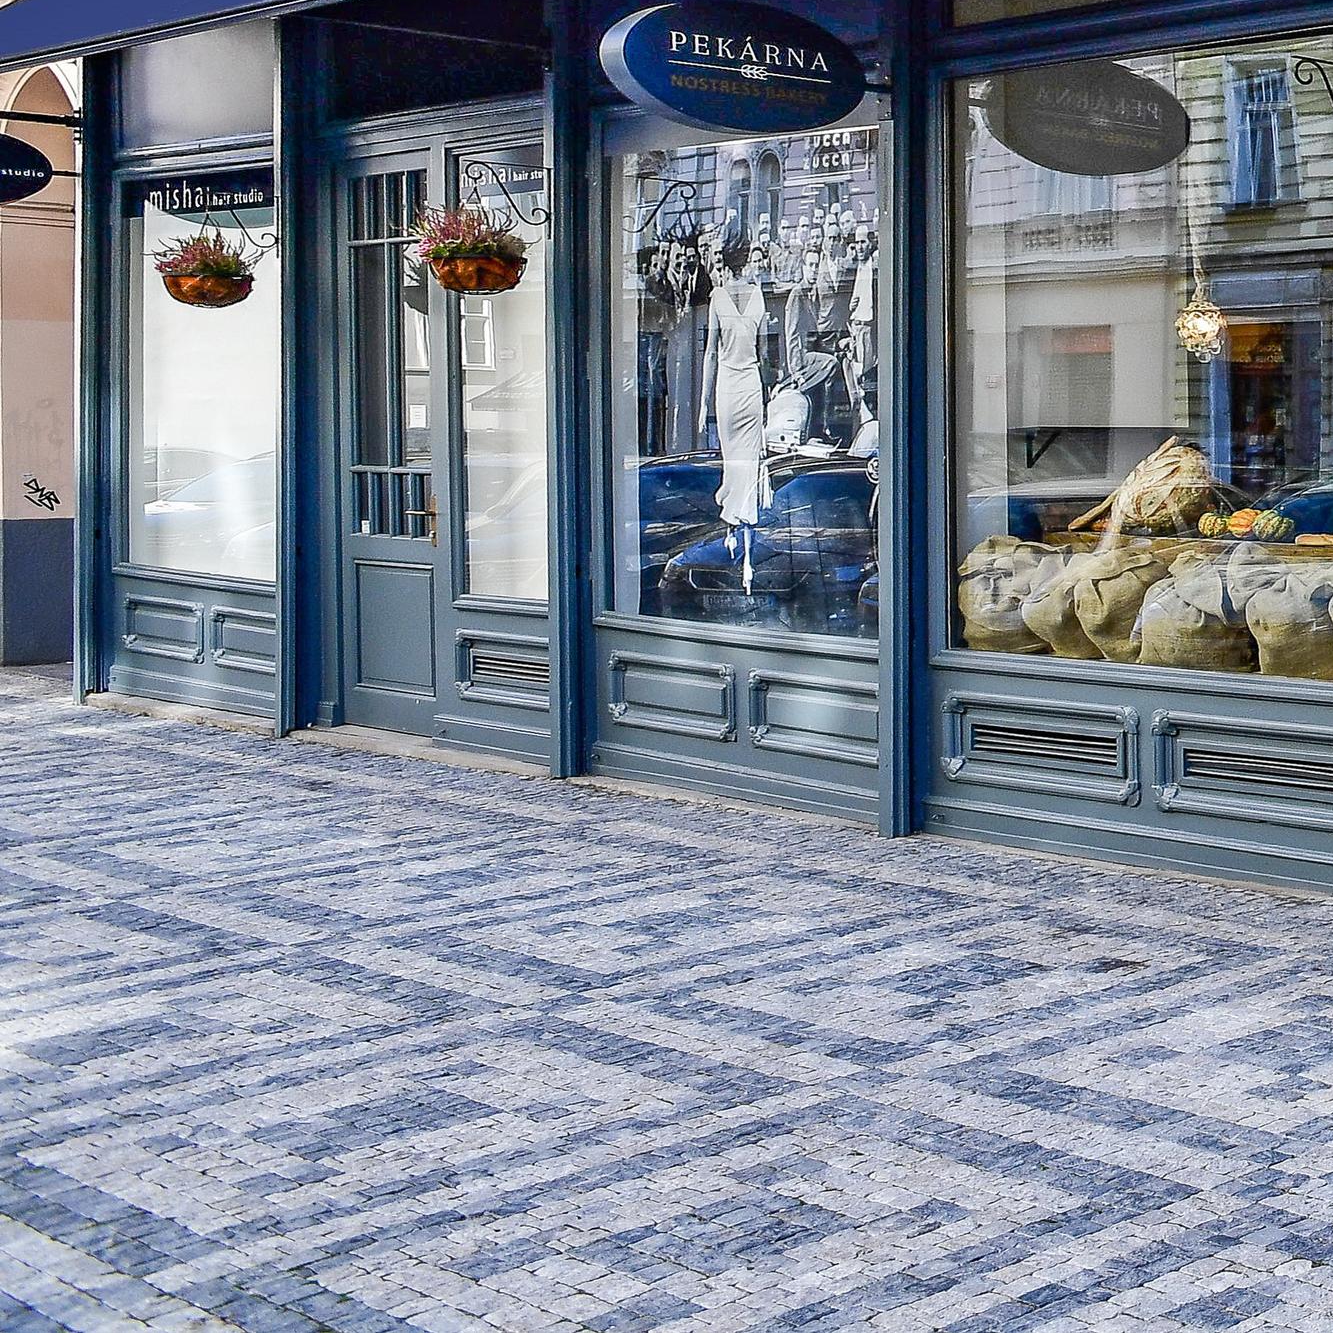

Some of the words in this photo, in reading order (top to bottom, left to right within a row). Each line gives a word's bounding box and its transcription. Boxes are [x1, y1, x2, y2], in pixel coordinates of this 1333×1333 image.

[669, 30, 828, 72] PEKÁRNA
[671, 74, 760, 97] NOSTRESS
[0, 168, 45, 178] studio
[149, 180, 204, 211] misha
[234, 188, 264, 205] studio
